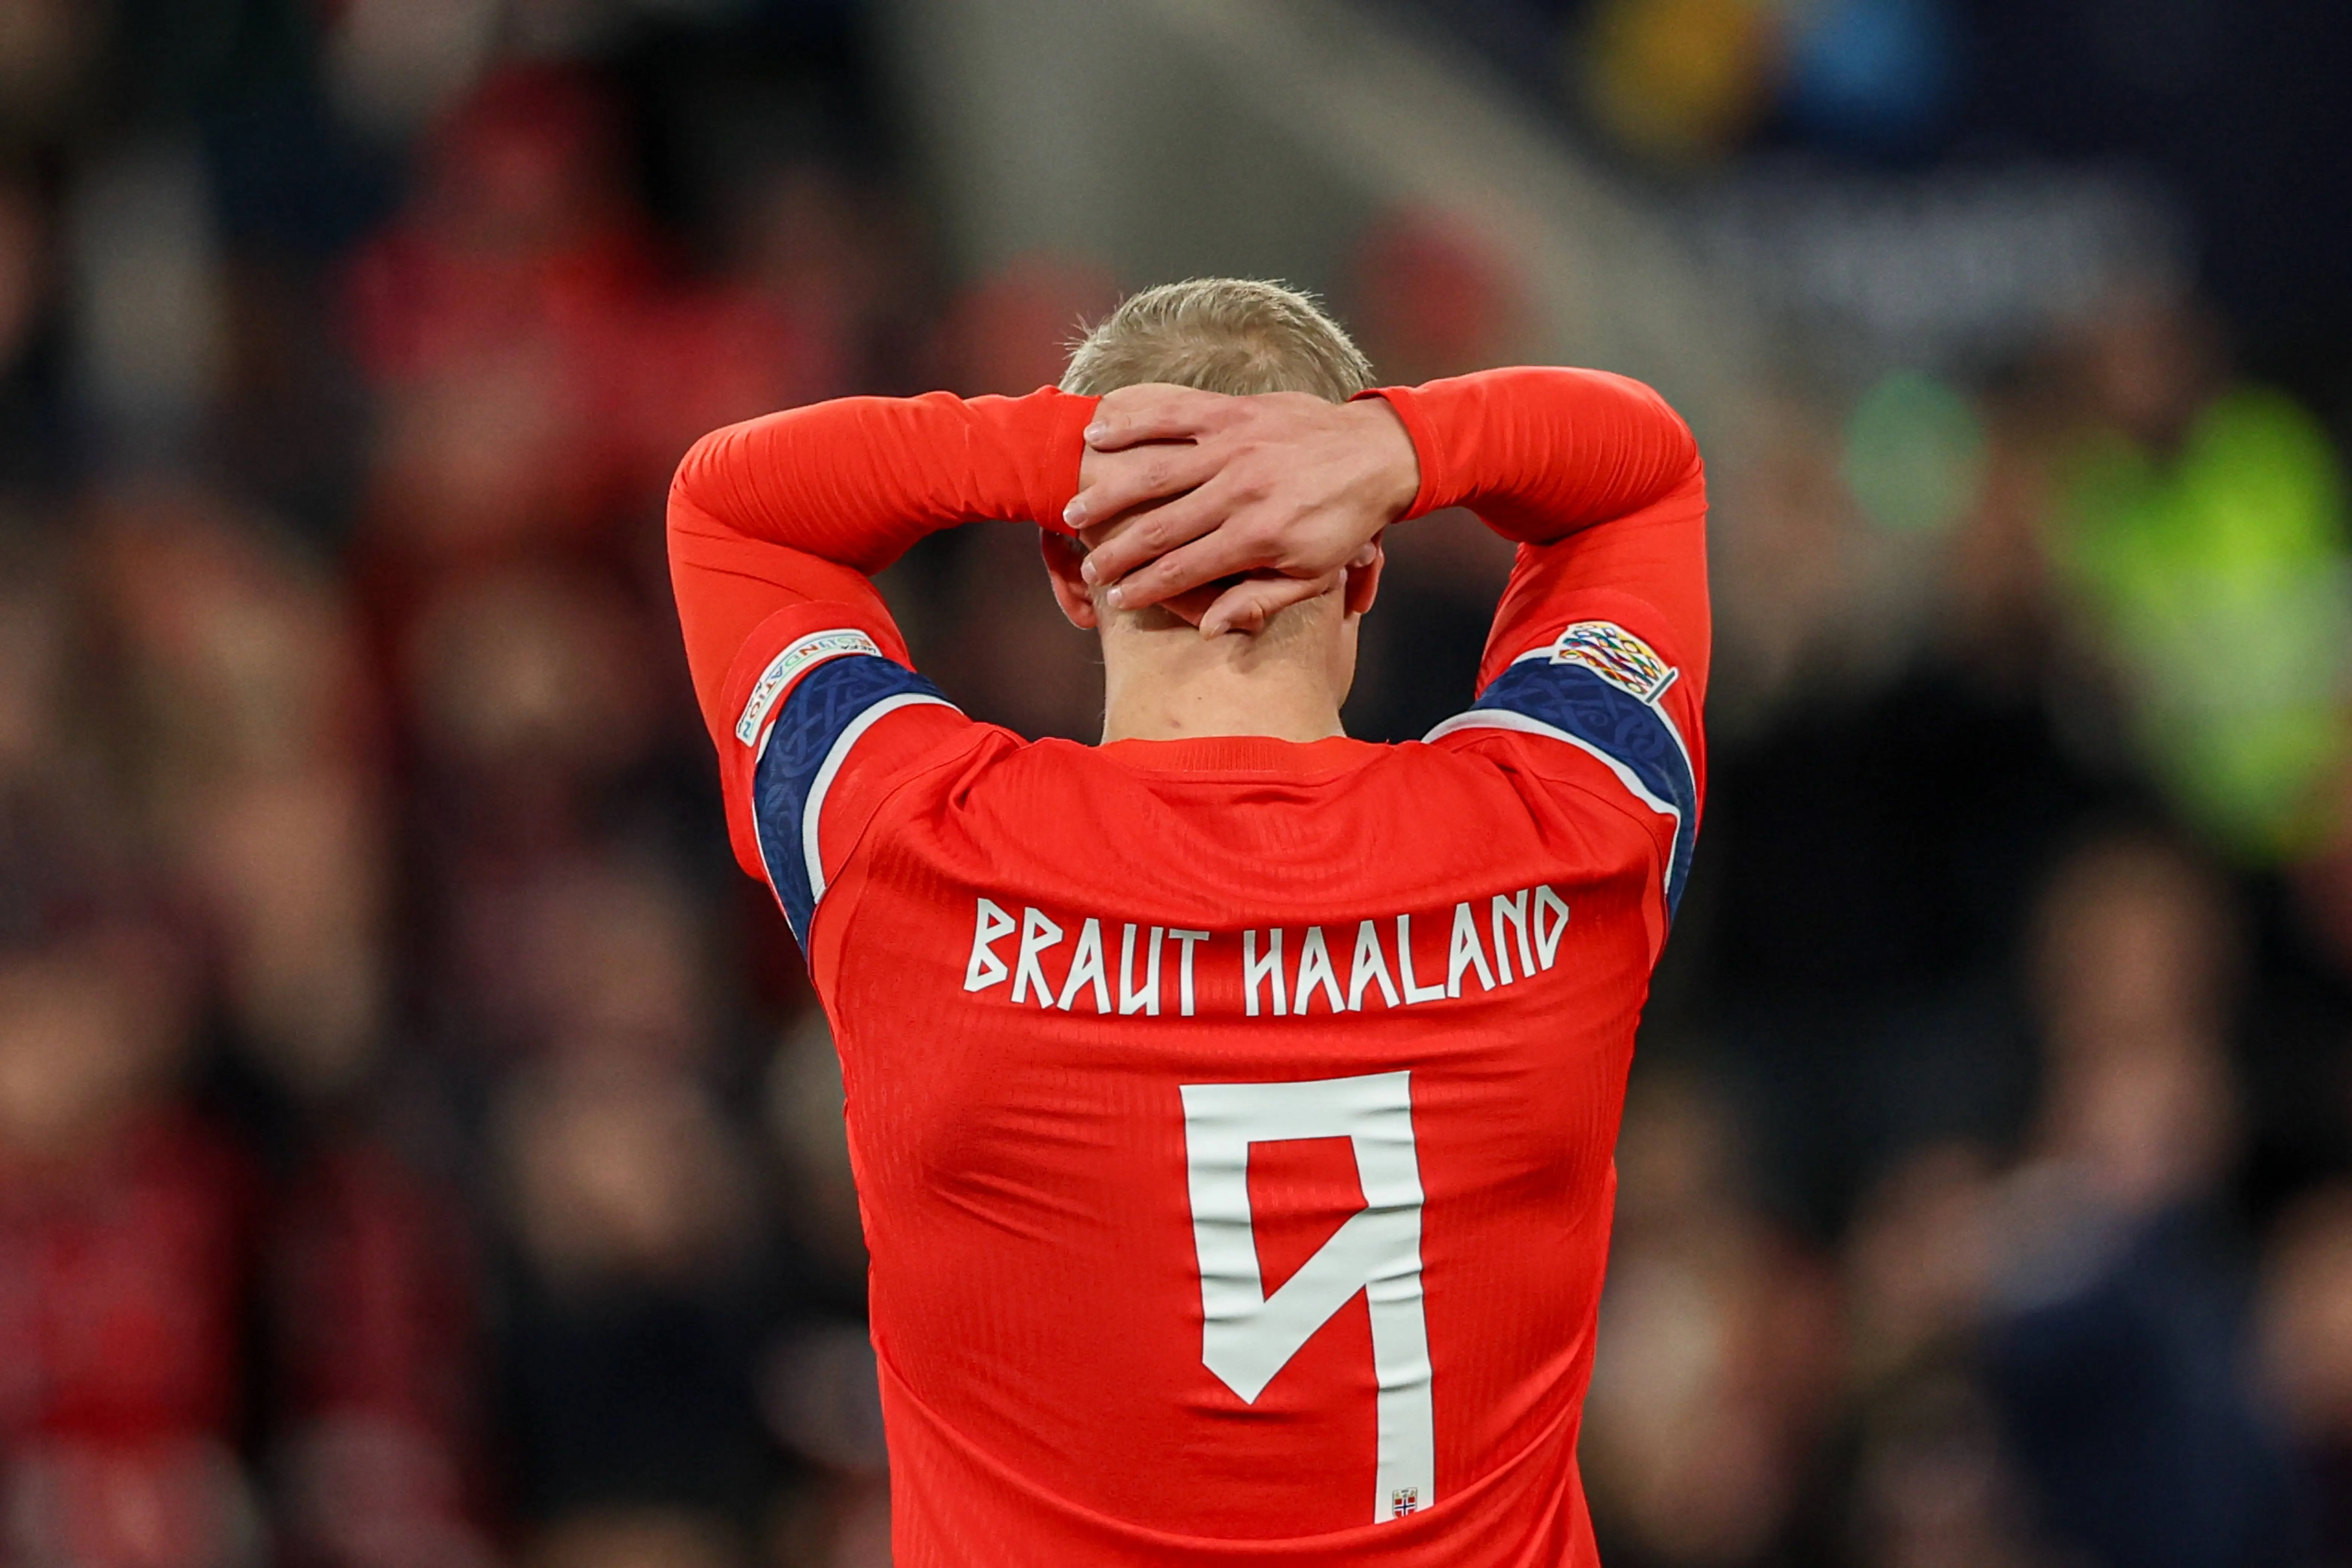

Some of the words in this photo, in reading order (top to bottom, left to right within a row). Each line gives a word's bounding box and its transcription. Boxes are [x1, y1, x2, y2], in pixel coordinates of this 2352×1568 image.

[841, 645, 877, 654] UEFA
[963, 897, 1210, 1017] BRAUT
[1243, 885, 1569, 1017] HAALAND
[1179, 1070, 1435, 1525] 9
